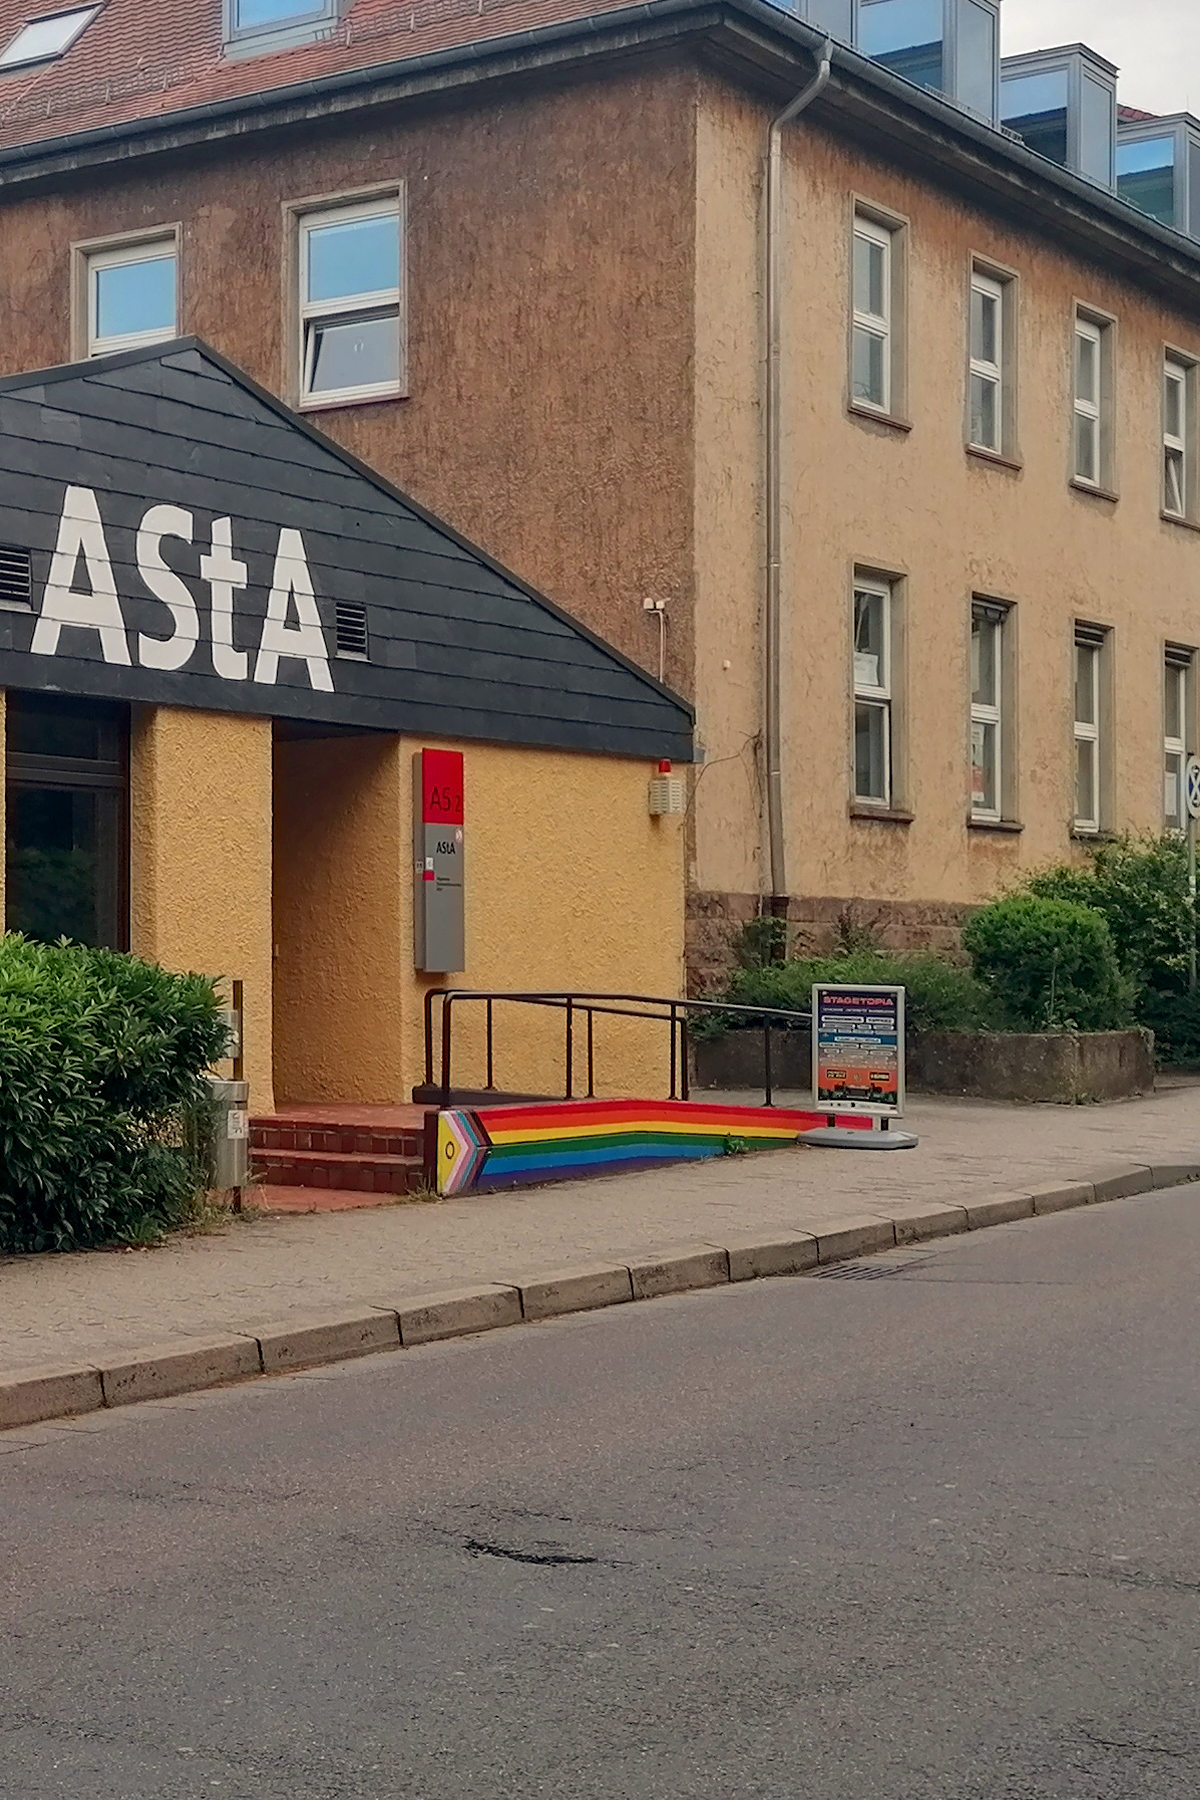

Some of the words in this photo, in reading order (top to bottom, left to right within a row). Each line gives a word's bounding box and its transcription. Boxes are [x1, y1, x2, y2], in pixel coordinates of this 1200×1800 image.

[30, 484, 335, 692] AStA
[430, 785, 452, 812] A5
[436, 841, 456, 855] AStA
